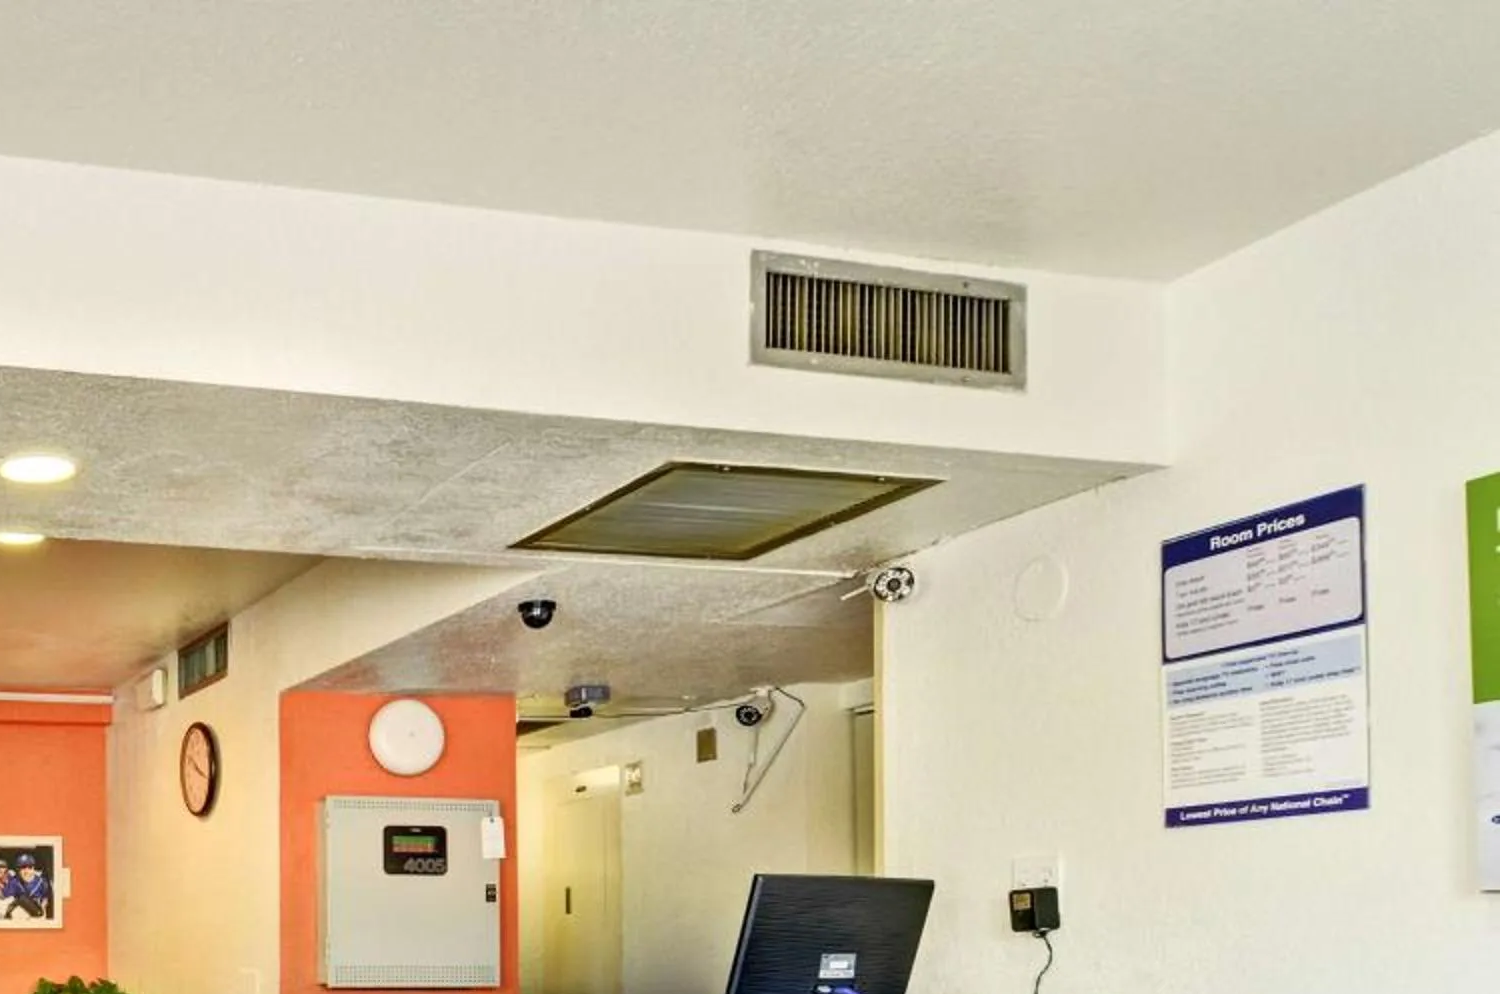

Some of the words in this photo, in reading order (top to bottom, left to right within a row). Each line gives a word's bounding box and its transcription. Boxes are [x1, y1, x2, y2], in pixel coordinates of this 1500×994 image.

[1209, 529, 1253, 551] Room
[1257, 513, 1307, 537] Prices
[1180, 810, 1212, 821] Lowest
[1213, 808, 1237, 817] Price
[1238, 805, 1248, 814] of
[1250, 803, 1269, 815] Any
[1270, 800, 1311, 811] National
[403, 858, 445, 873] 4005
